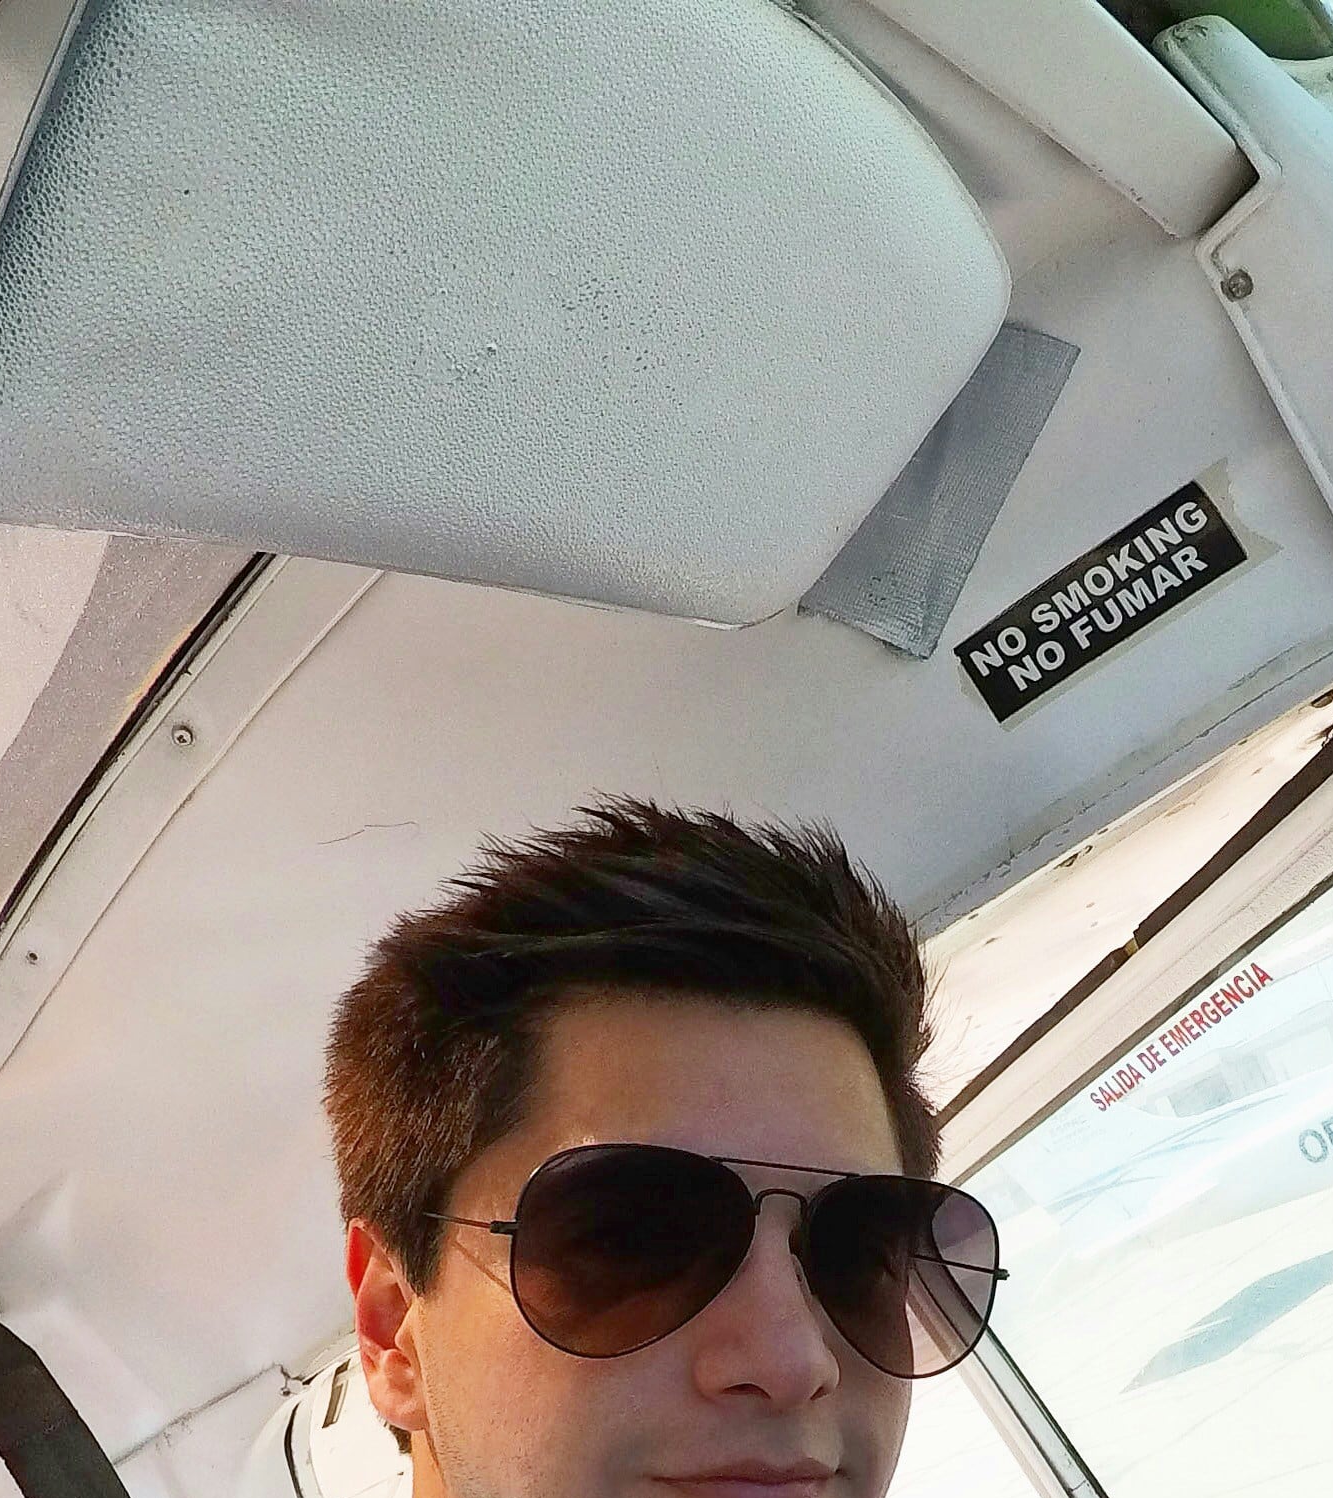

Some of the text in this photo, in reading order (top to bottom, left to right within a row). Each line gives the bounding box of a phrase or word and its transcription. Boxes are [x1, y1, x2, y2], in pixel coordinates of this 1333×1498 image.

[969, 502, 1208, 678] NO SMOKING
[1008, 546, 1208, 691] NO FUMAR
[1089, 962, 1275, 1112] SALIDA DE EMERGENCIA
